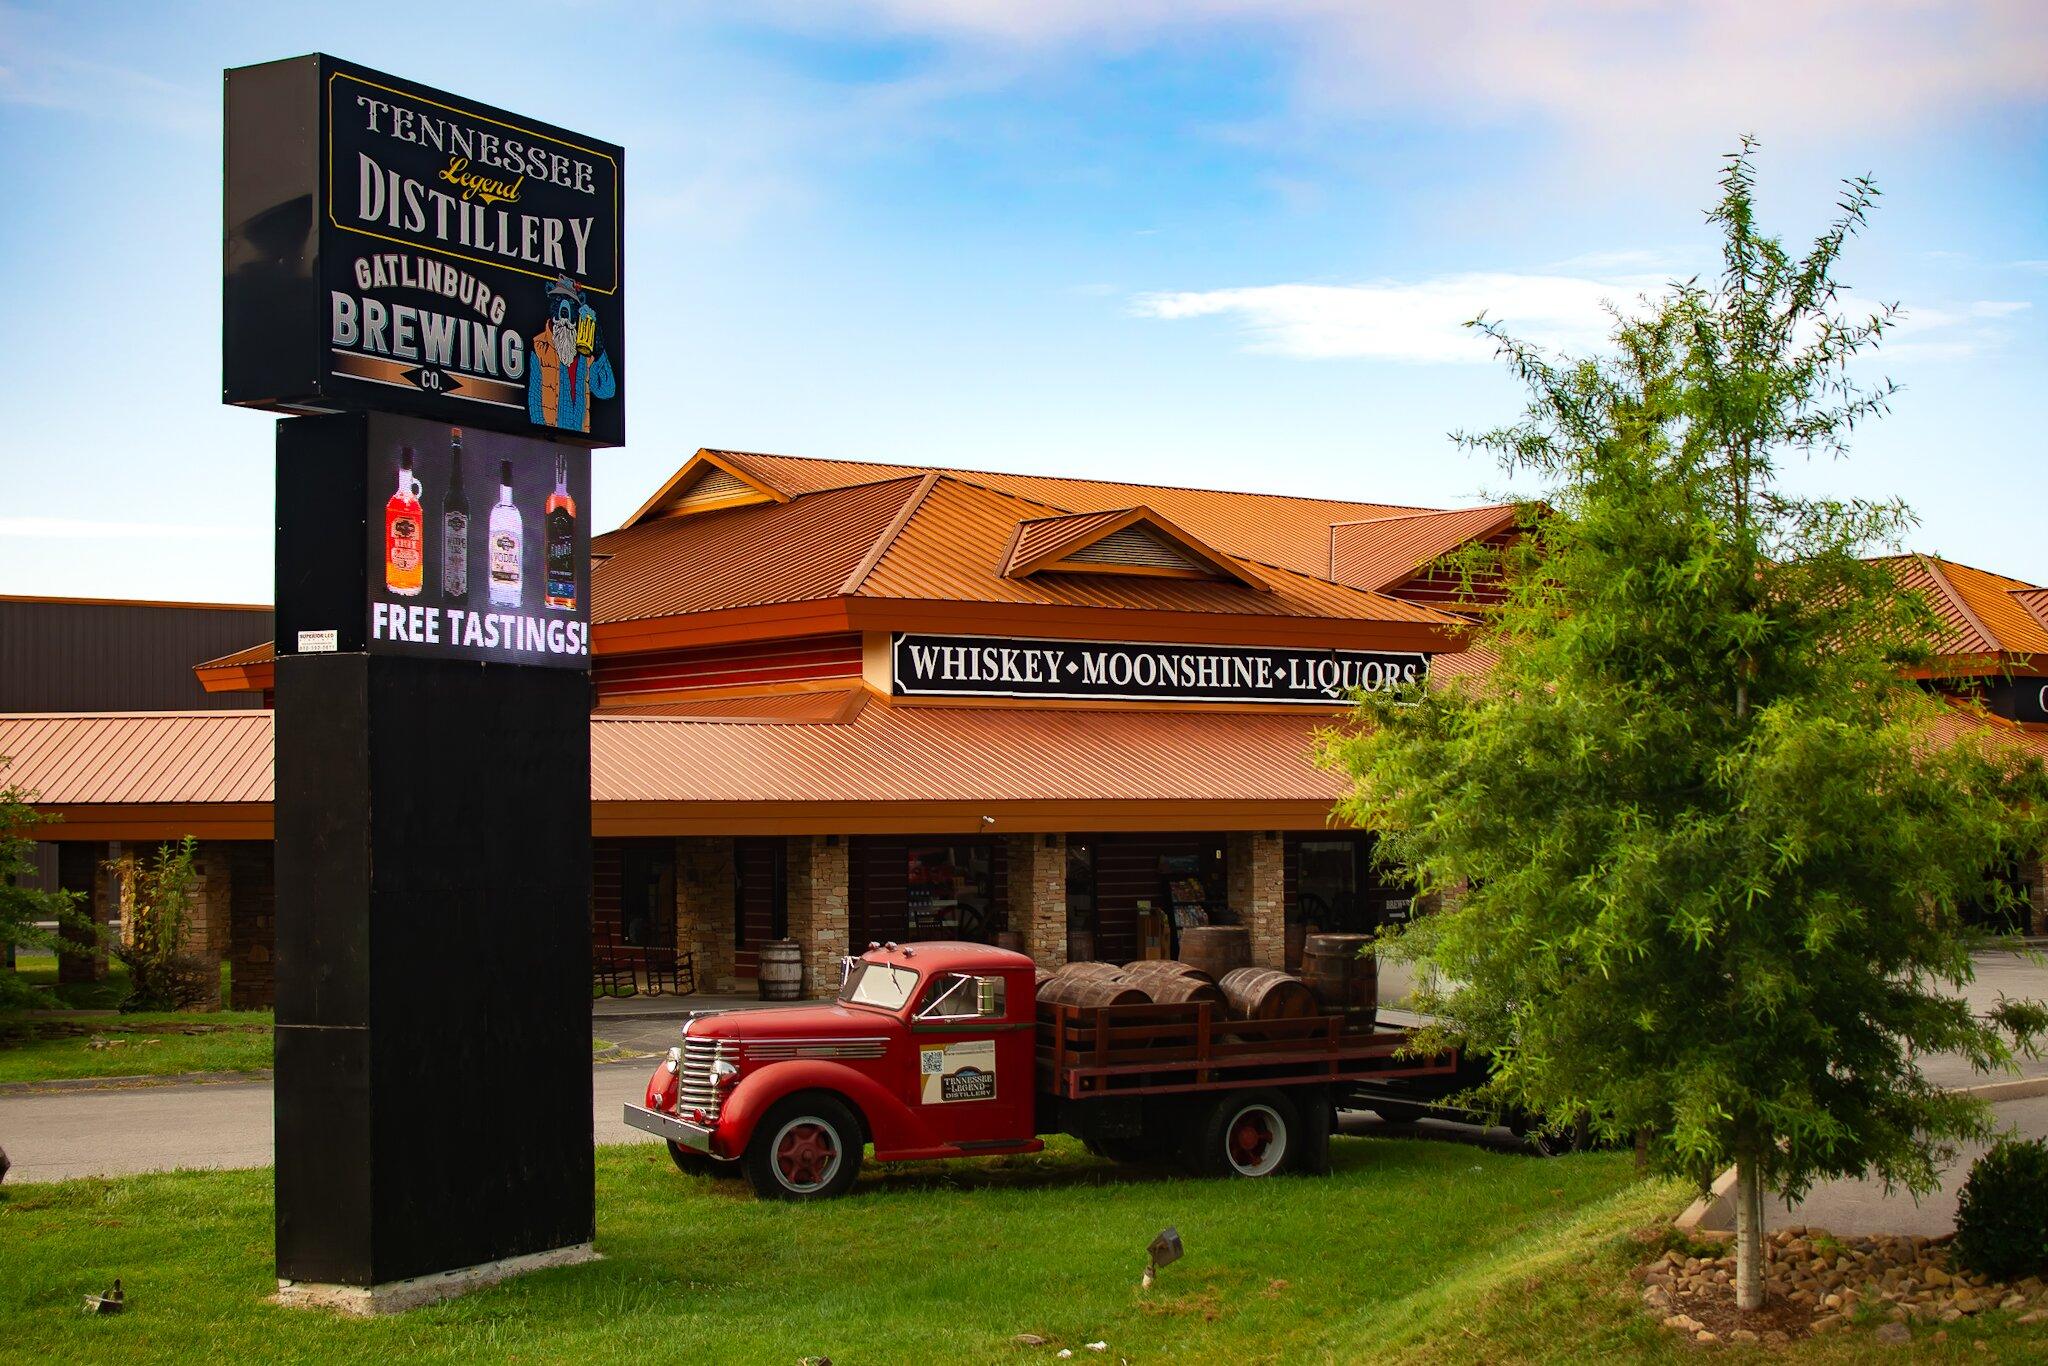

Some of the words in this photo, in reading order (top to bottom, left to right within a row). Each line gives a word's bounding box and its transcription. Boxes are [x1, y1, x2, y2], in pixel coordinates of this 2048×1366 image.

[357, 95, 595, 195] TENNESSEE
[438, 156, 524, 205] Legend
[357, 151, 595, 275] DISTILLERY
[354, 254, 507, 325] GATLINBURG
[331, 290, 526, 379] BREWING
[420, 369, 443, 391] CO.
[372, 602, 440, 643] FREE
[447, 608, 588, 656] TASTINGS!
[908, 645, 1066, 683] WHISKEY
[1082, 653, 1273, 689] MOONSHINE
[1288, 658, 1417, 697] LIQUORS
[943, 1075, 993, 1086] TENNESSEE
[945, 1090, 991, 1099] DISTILLERY
[951, 1082, 986, 1093] LEGEND
